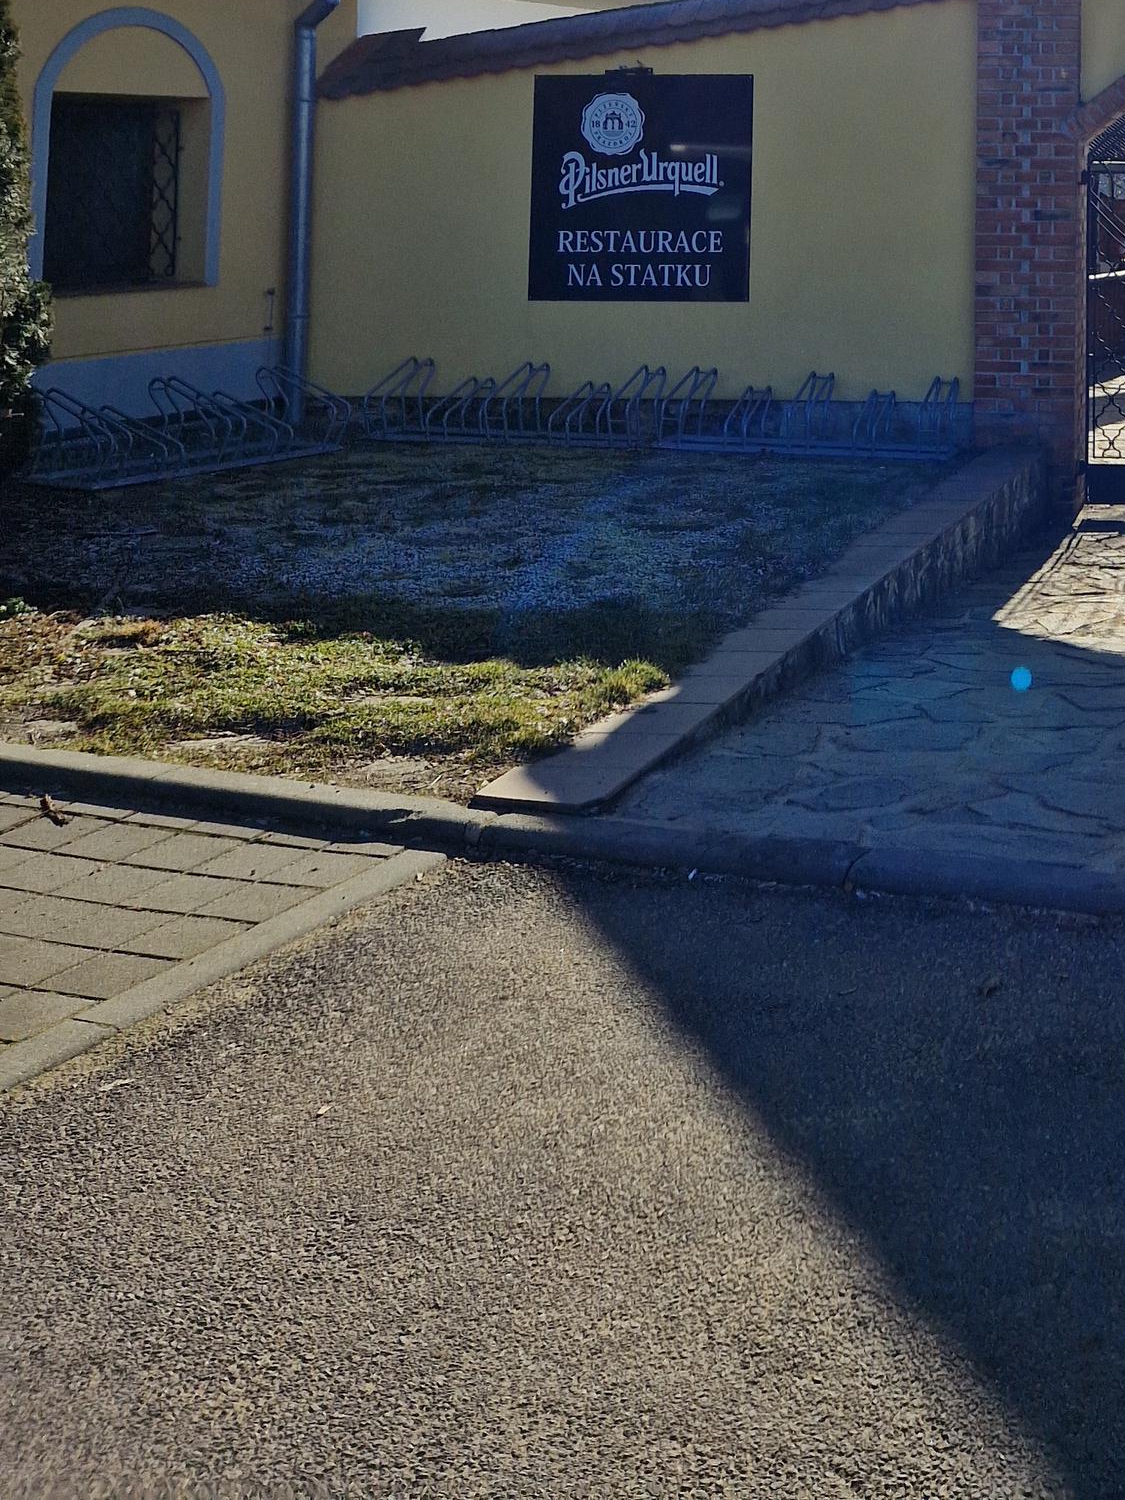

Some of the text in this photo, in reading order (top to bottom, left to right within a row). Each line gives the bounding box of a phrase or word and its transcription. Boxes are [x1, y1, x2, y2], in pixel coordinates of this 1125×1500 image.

[559, 148, 718, 209] Pilsner Urquell
[557, 230, 723, 253] RESTAURACE
[567, 263, 711, 287] NA STATKU
